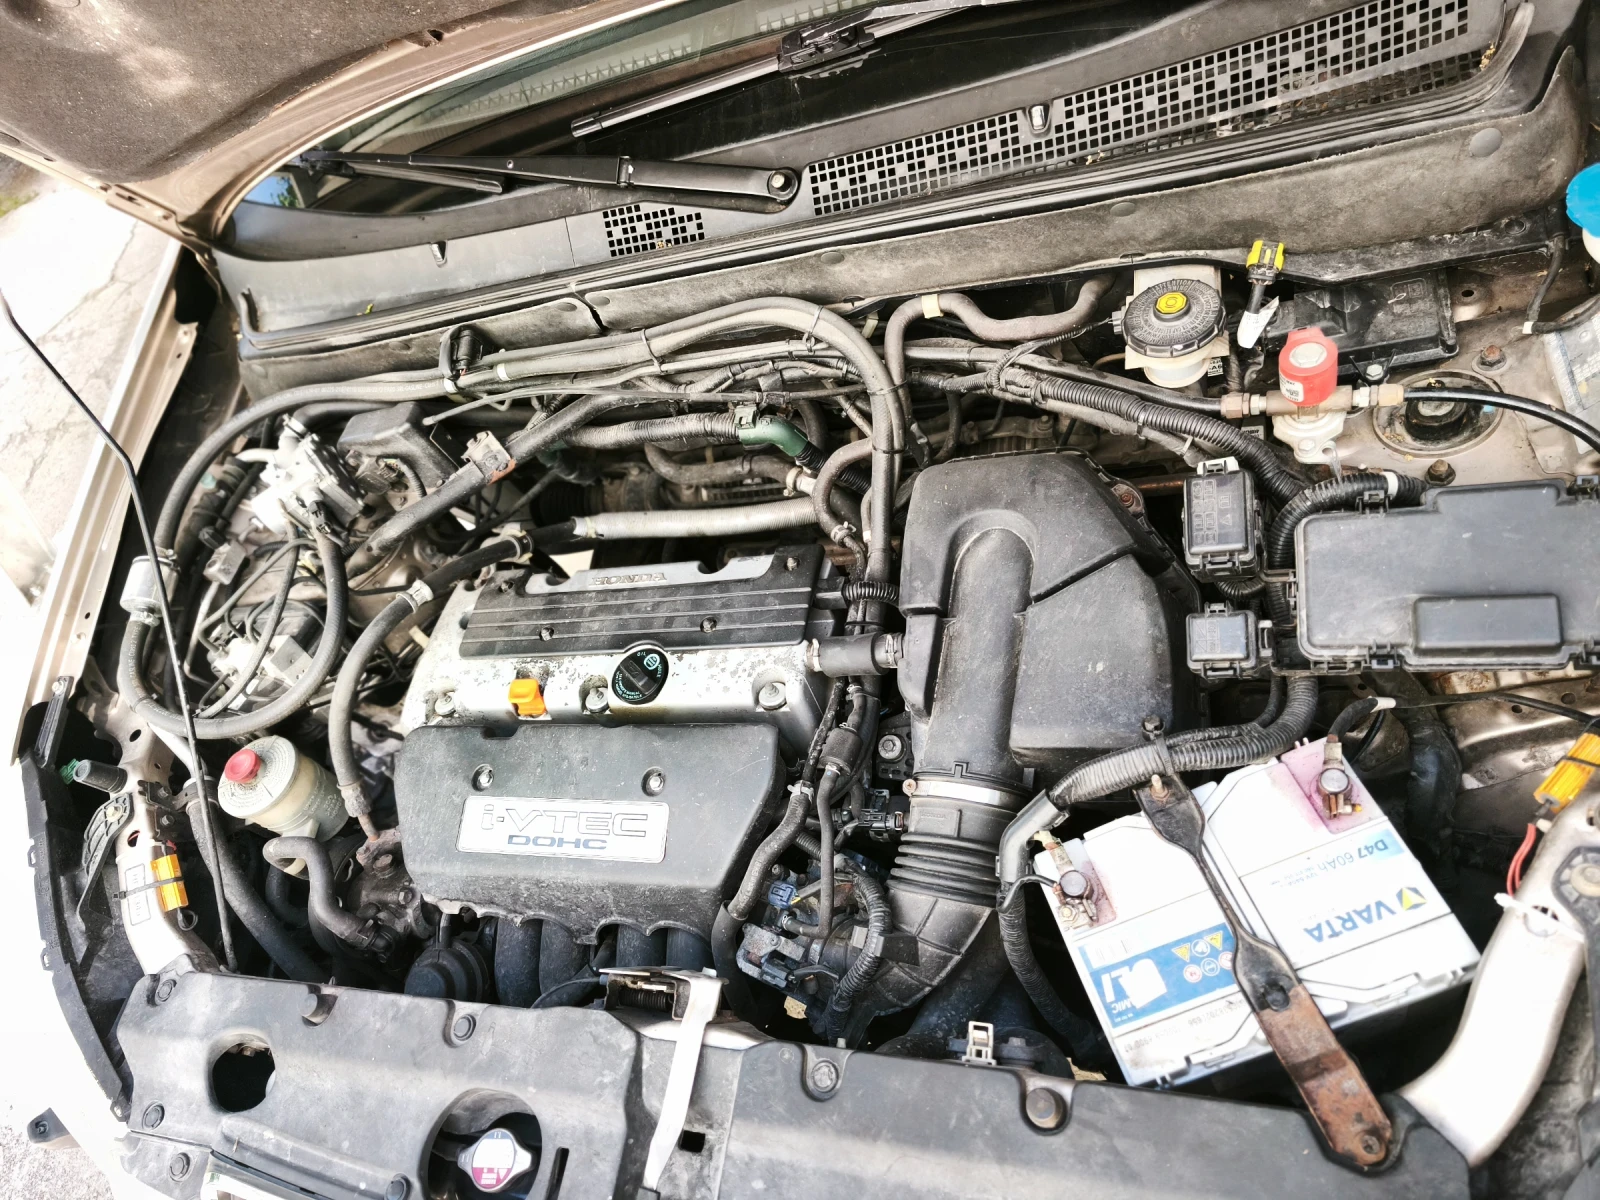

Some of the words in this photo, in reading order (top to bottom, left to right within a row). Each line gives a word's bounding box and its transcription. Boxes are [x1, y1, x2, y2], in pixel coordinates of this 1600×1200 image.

[1156, 280, 1193, 291] ATTENTION
[589, 572, 668, 586] HONDA
[481, 804, 648, 837] i-VTEC
[507, 834, 608, 850] DOHC
[1357, 839, 1389, 859] D47
[1317, 852, 1354, 872] 60Ah
[1303, 900, 1397, 943] VARTA
